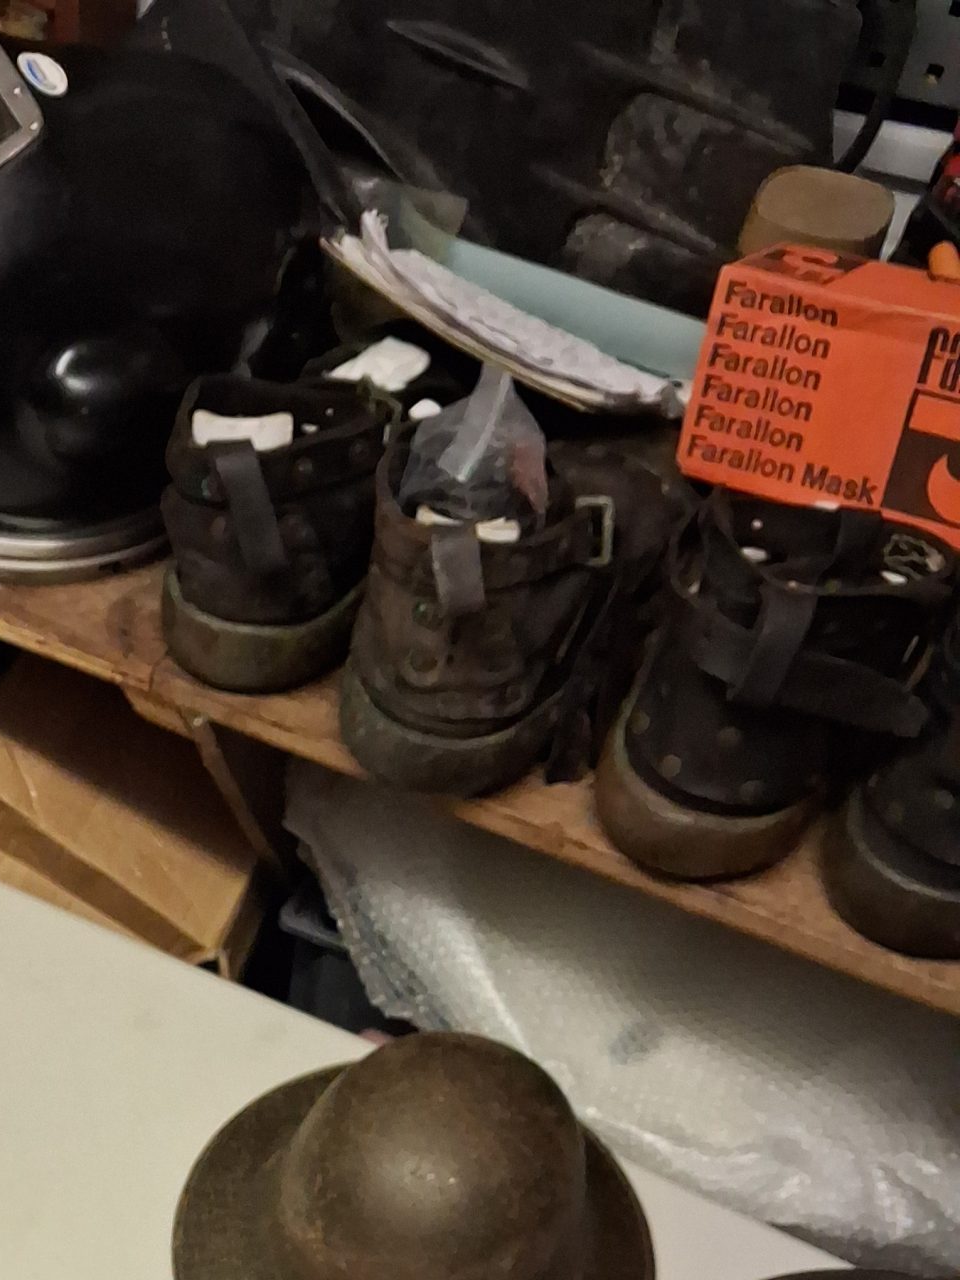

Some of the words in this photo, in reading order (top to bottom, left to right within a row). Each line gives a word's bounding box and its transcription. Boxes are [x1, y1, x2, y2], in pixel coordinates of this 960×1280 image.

[724, 279, 839, 328] Farallon
[716, 312, 832, 360] Farallon
[707, 342, 822, 392] Farallon
[700, 373, 813, 422] Farallon
[693, 404, 804, 452] Farallon
[686, 434, 795, 483] Farallon
[800, 462, 879, 505] Mask
